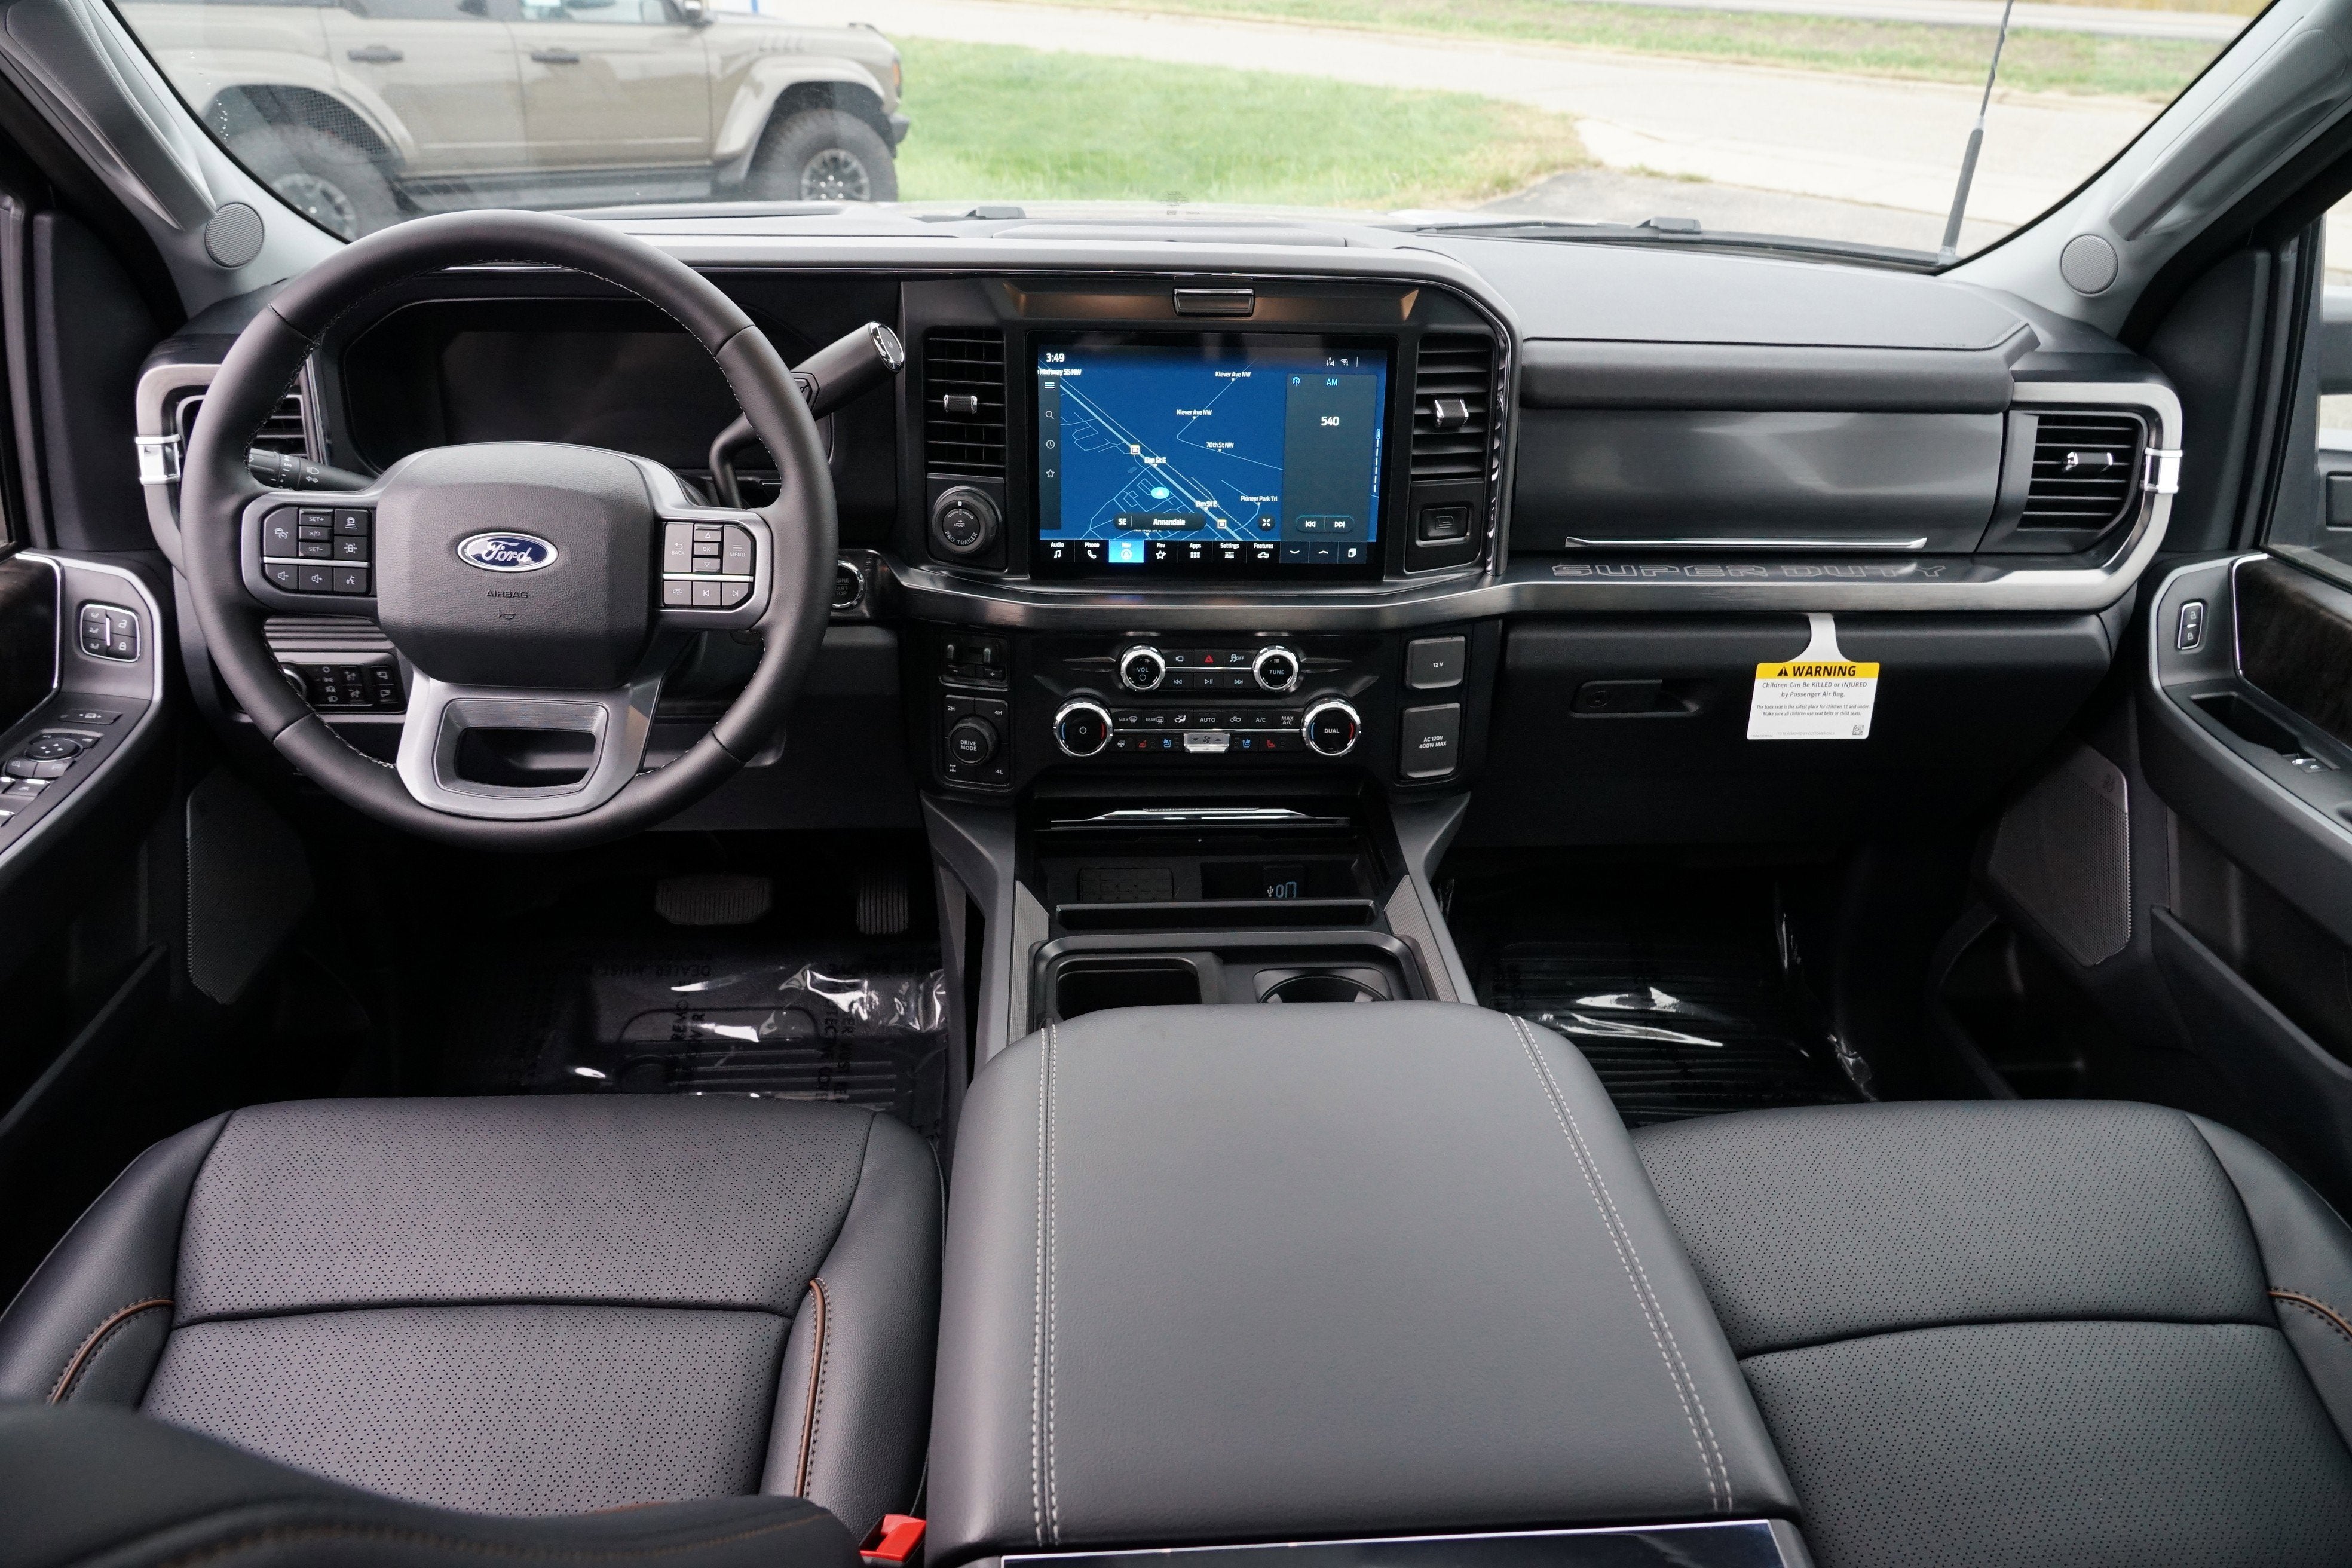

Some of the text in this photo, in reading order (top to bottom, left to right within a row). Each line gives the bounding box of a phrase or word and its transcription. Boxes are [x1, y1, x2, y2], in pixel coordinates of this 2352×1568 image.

[1046, 353, 1065, 362] 3:49
[1326, 378, 1338, 387] AM
[1321, 416, 1339, 426] 540
[944, 531, 978, 546] PRO TRAILER
[482, 540, 532, 563] Ford
[1551, 564, 1946, 577] SUPER DUTY
[485, 589, 529, 598] AIRBAG
[1793, 665, 1857, 677] WARNING
